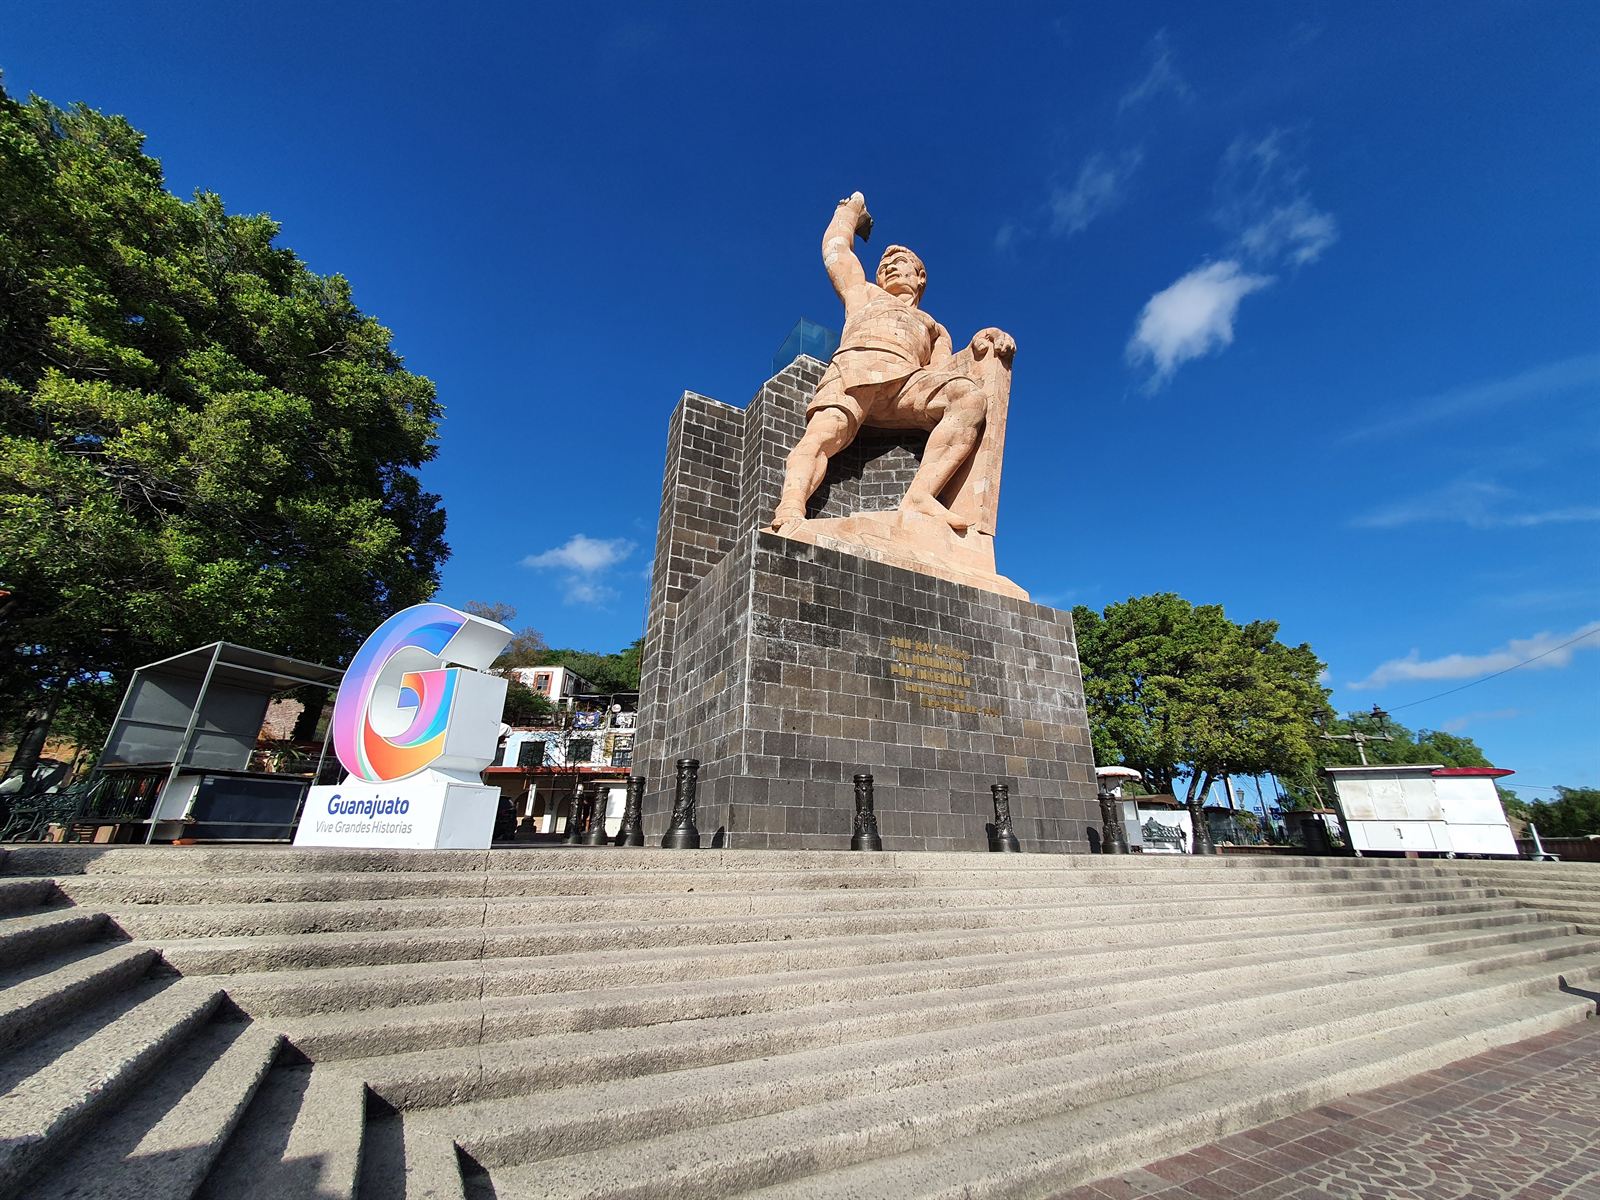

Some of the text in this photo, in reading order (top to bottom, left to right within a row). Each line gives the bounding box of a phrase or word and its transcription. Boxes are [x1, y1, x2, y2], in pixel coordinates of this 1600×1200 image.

[327, 794, 410, 819] Guanajuato
[316, 820, 413, 834] Vive Grandes Historias
